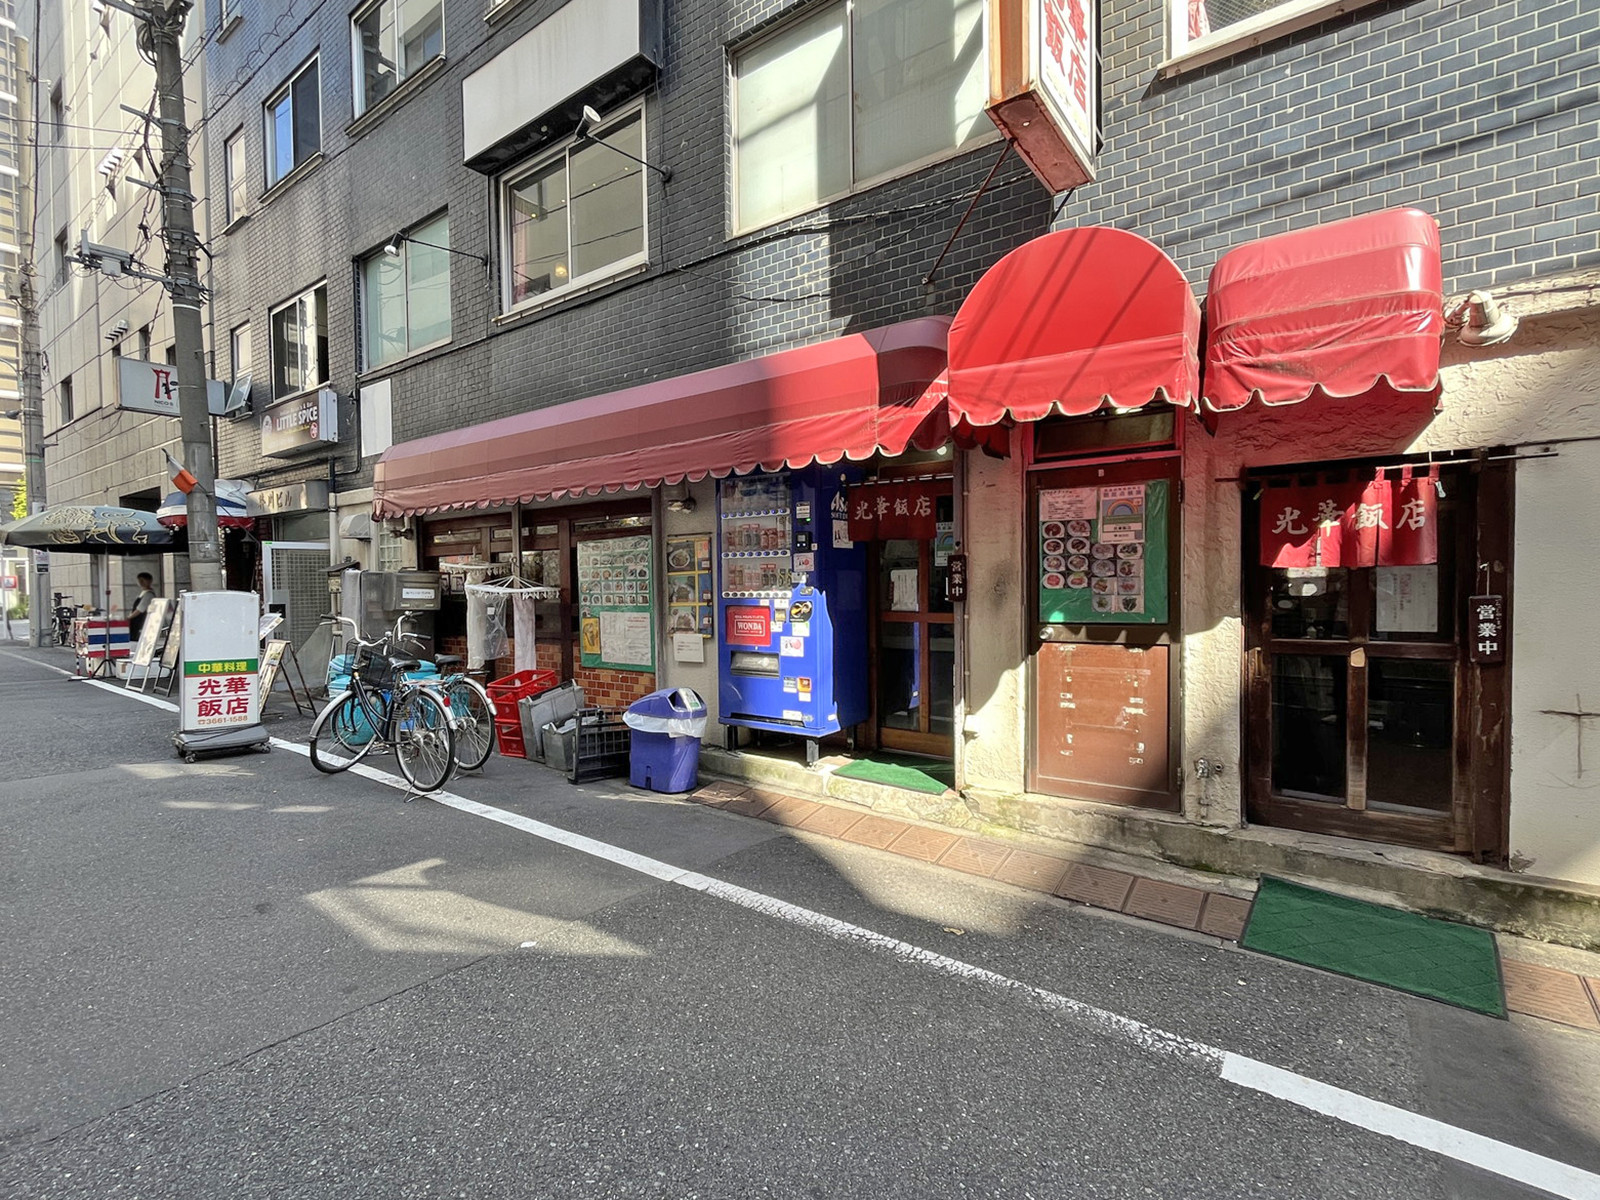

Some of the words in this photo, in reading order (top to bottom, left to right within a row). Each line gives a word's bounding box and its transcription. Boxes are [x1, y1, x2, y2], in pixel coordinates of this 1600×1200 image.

[276, 412, 298, 432] LITTLE
[298, 406, 318, 425] SPICE
[854, 496, 932, 521] 光華飯店
[1271, 498, 1427, 535] 光華飯店
[951, 561, 963, 597] 営業中
[1477, 604, 1498, 655] 営業中
[198, 661, 247, 673] 中華料理
[197, 677, 251, 696] 光華
[197, 697, 249, 717] 飯店
